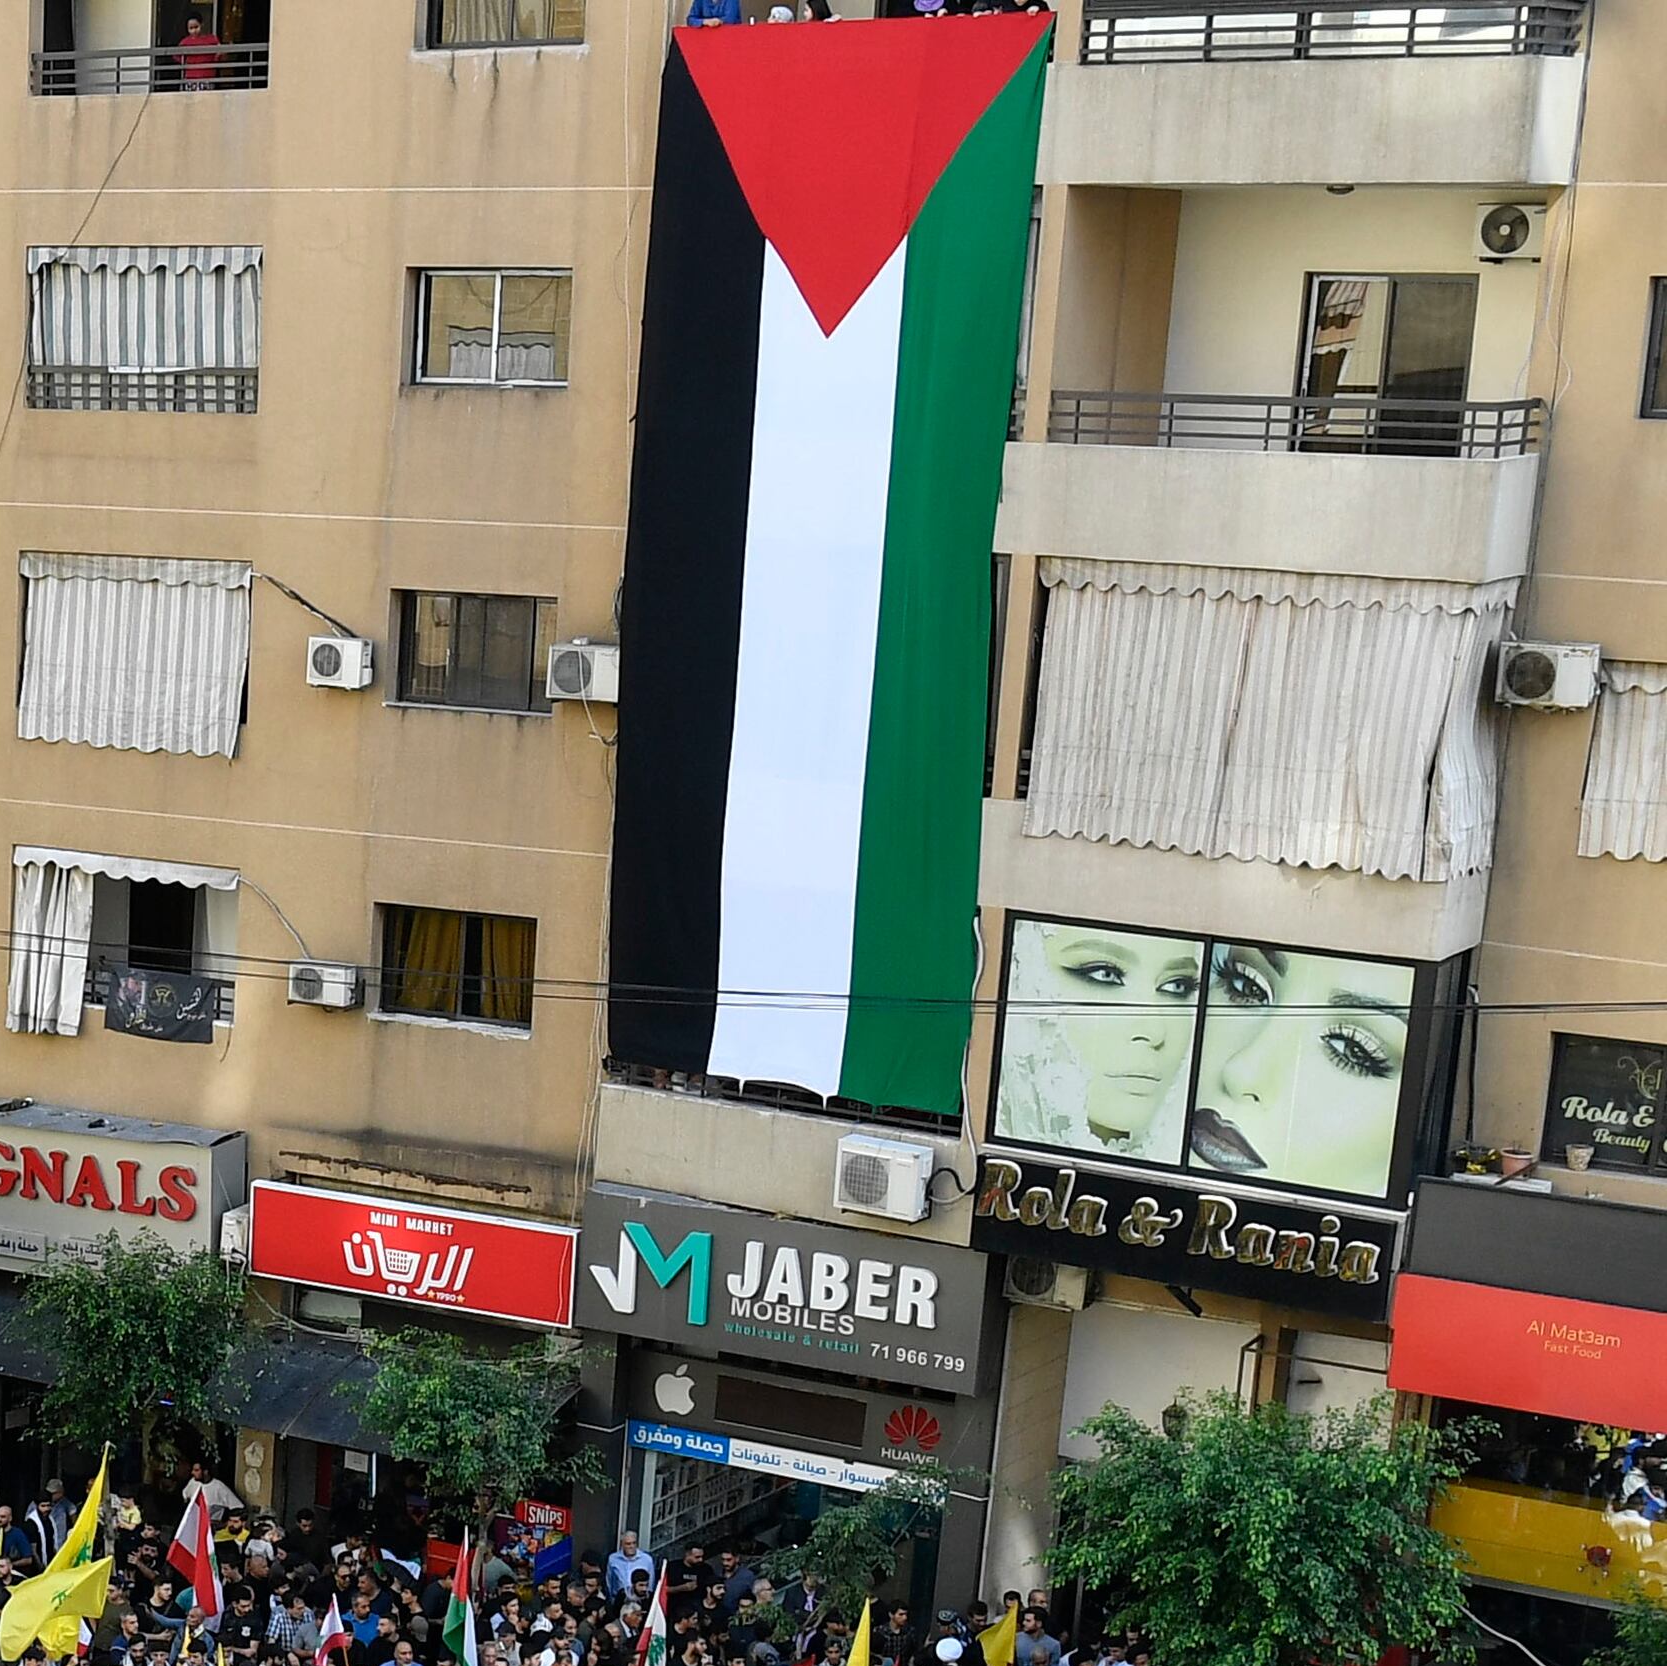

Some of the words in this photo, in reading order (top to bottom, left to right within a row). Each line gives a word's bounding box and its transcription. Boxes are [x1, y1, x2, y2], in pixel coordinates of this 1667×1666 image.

[1561, 1096, 1628, 1125] Rola
[1632, 1105, 1656, 1128] &
[1593, 1128, 1651, 1154] Beauty
[370, 1211, 398, 1228] MINI
[405, 1215, 454, 1236] MARKET
[975, 1158, 1108, 1237] Rola
[1118, 1197, 1183, 1247] &
[1187, 1194, 1382, 1285] Rania
[726, 1240, 939, 1330] JABER
[730, 1297, 856, 1336] MOBILES
[724, 1321, 795, 1344] wholesale
[803, 1334, 811, 1346] &
[819, 1338, 860, 1355] retail
[1526, 1320, 1545, 1336] Al
[1550, 1322, 1621, 1348] Mat3am
[870, 1343, 890, 1360] 71
[896, 1347, 928, 1367] 966
[933, 1353, 966, 1373] 799
[1544, 1341, 1569, 1354] Fast
[1572, 1345, 1602, 1360] Food
[686, 1434, 723, 1457] جملة
[731, 1447, 781, 1468] تلفونات
[881, 1447, 939, 1467] HUAWEI
[793, 1456, 827, 1476] صيانة
[528, 1506, 563, 1525] SNIPS
